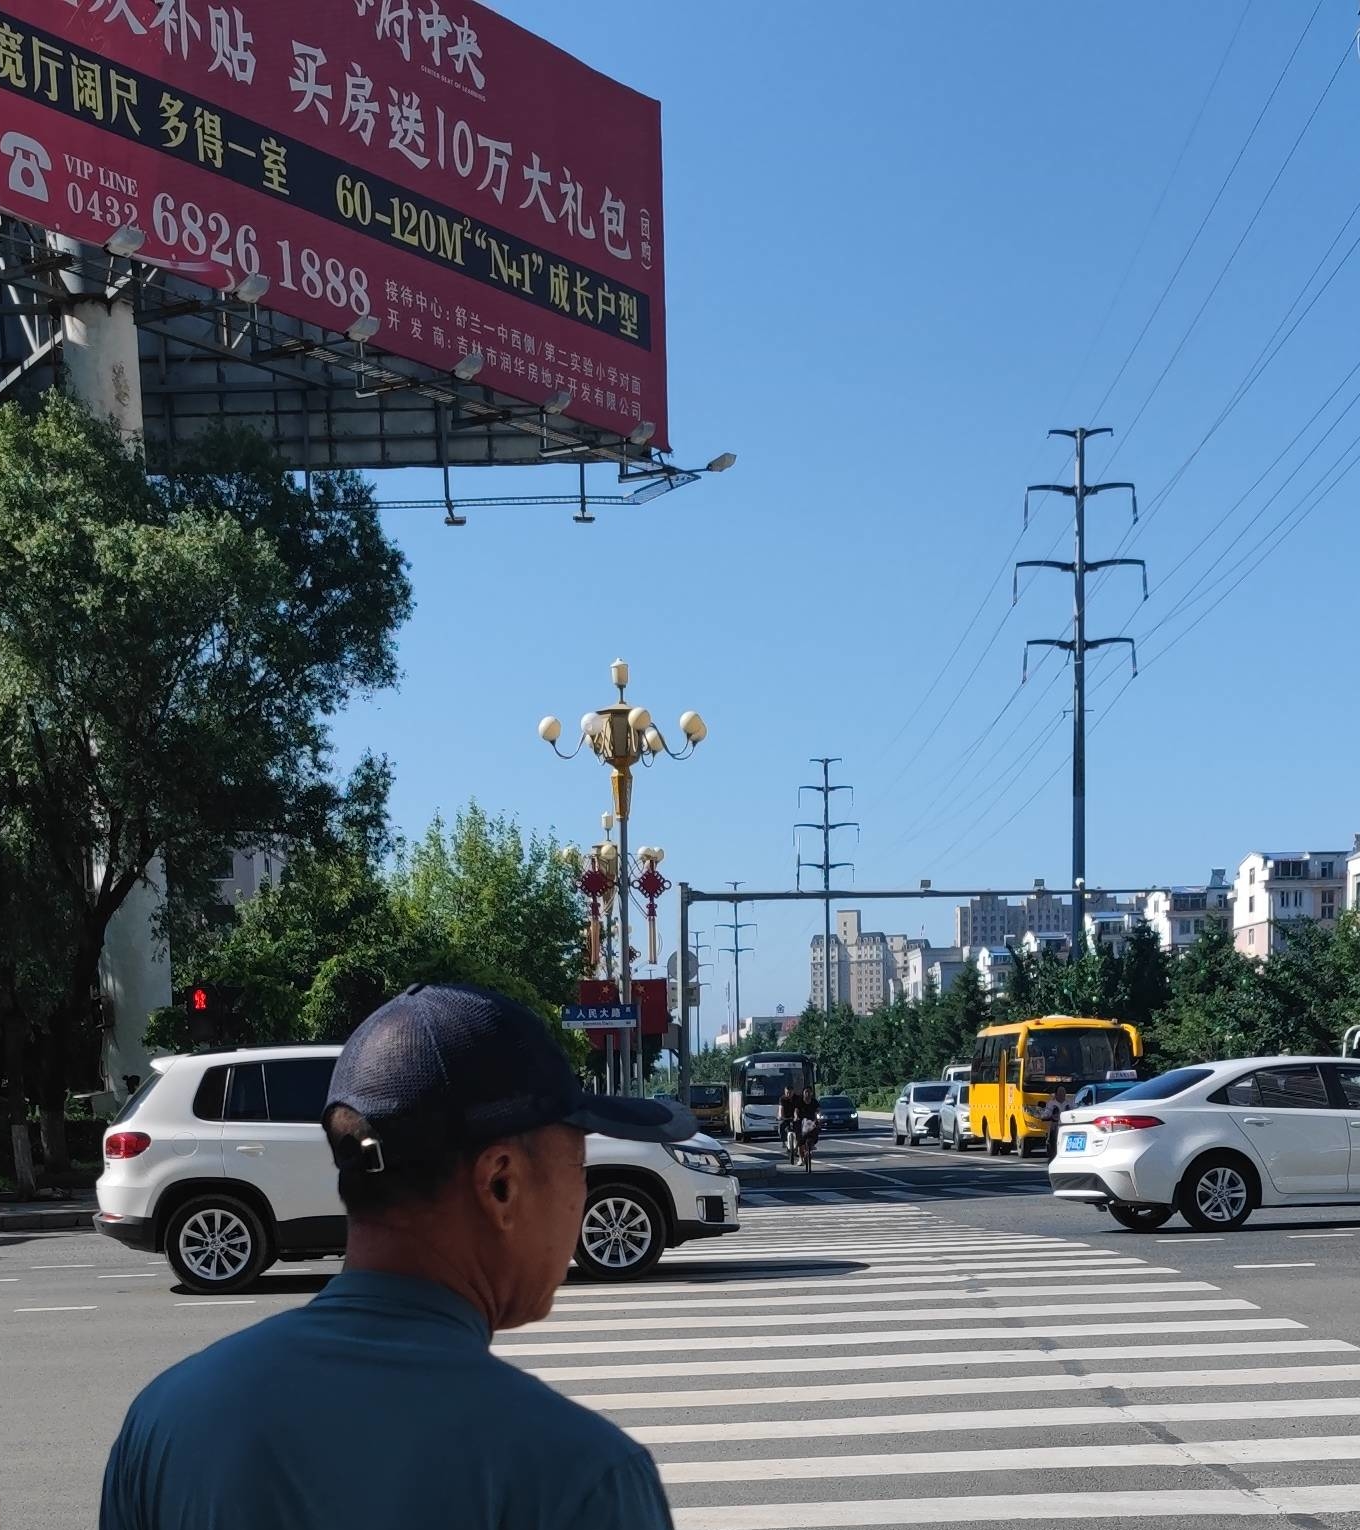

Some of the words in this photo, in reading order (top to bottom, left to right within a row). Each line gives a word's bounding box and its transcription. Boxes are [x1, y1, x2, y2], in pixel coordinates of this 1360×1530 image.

[354, 0, 486, 90] 府中央
[64, 153, 94, 181] VIP
[99, 167, 139, 198] LINE
[159, 92, 290, 196] 多得一室
[289, 39, 632, 261] 买房送10万大礼包
[67, 182, 139, 229] 0432
[153, 192, 261, 274] 6826
[276, 239, 371, 317] 1888
[576, 1007, 621, 1019] 人民大路
